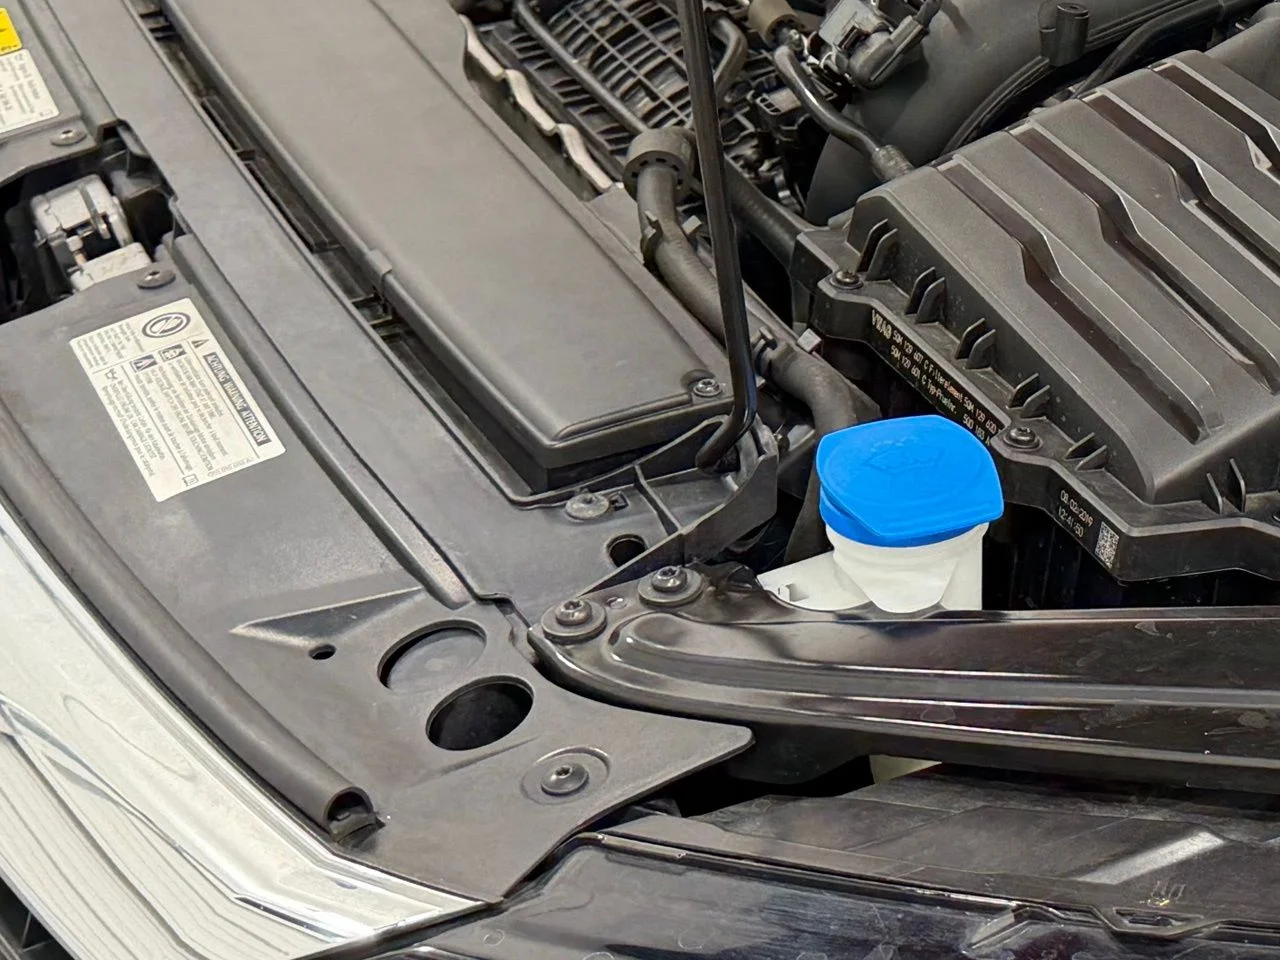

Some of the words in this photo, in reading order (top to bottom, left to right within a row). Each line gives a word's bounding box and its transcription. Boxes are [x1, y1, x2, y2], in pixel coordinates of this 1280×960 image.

[207, 353, 228, 382] ACHTUNG
[223, 379, 247, 410] WARNING
[241, 409, 267, 443] ATTENTION
